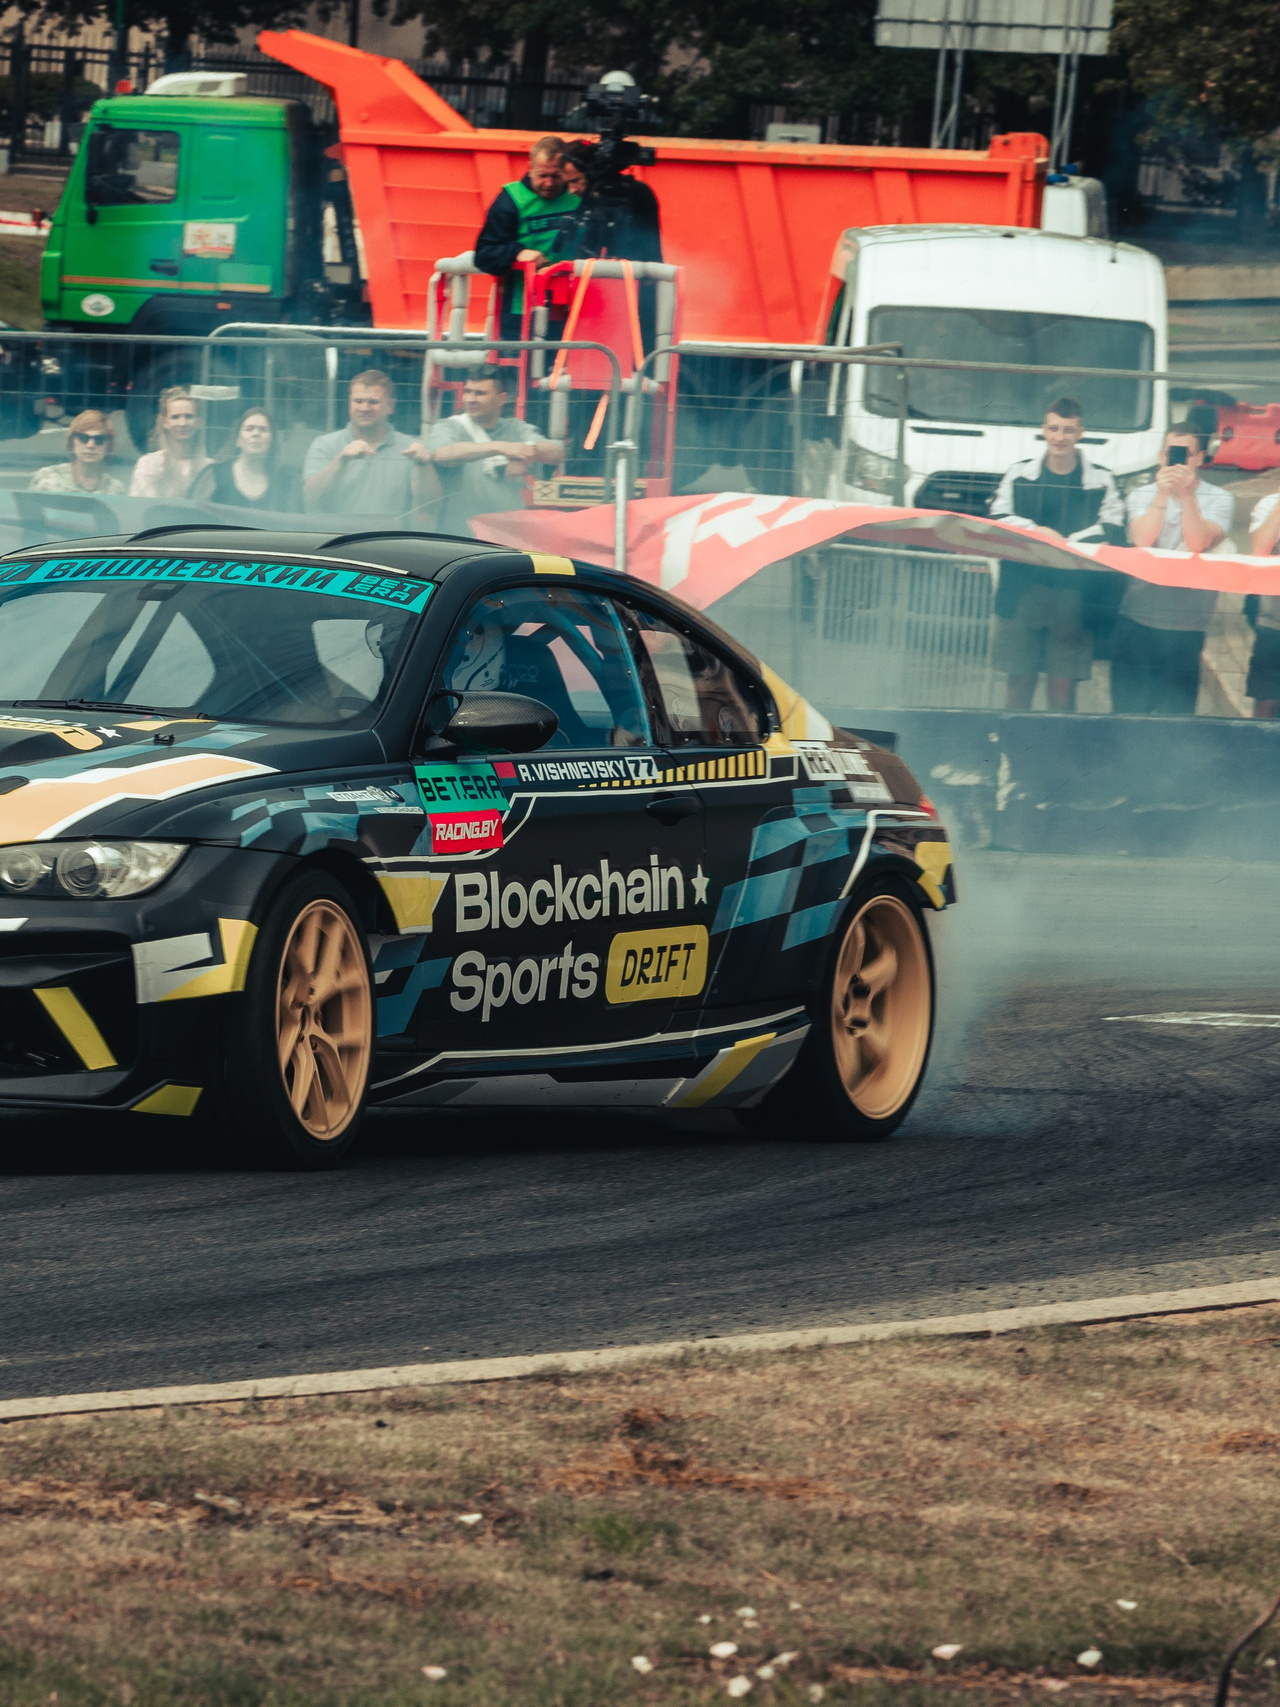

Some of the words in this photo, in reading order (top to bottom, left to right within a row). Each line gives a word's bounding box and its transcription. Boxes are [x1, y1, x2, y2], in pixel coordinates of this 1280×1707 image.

[360, 575, 419, 592] BET
[518, 760, 626, 782] A.VISHNEVSKY
[627, 758, 654, 778] 77
[418, 775, 506, 802] BET.ERA
[435, 818, 499, 841] RACING.BY
[455, 854, 684, 933] Blockchain
[450, 940, 599, 1022] Sports
[620, 942, 696, 987] DRIFT
